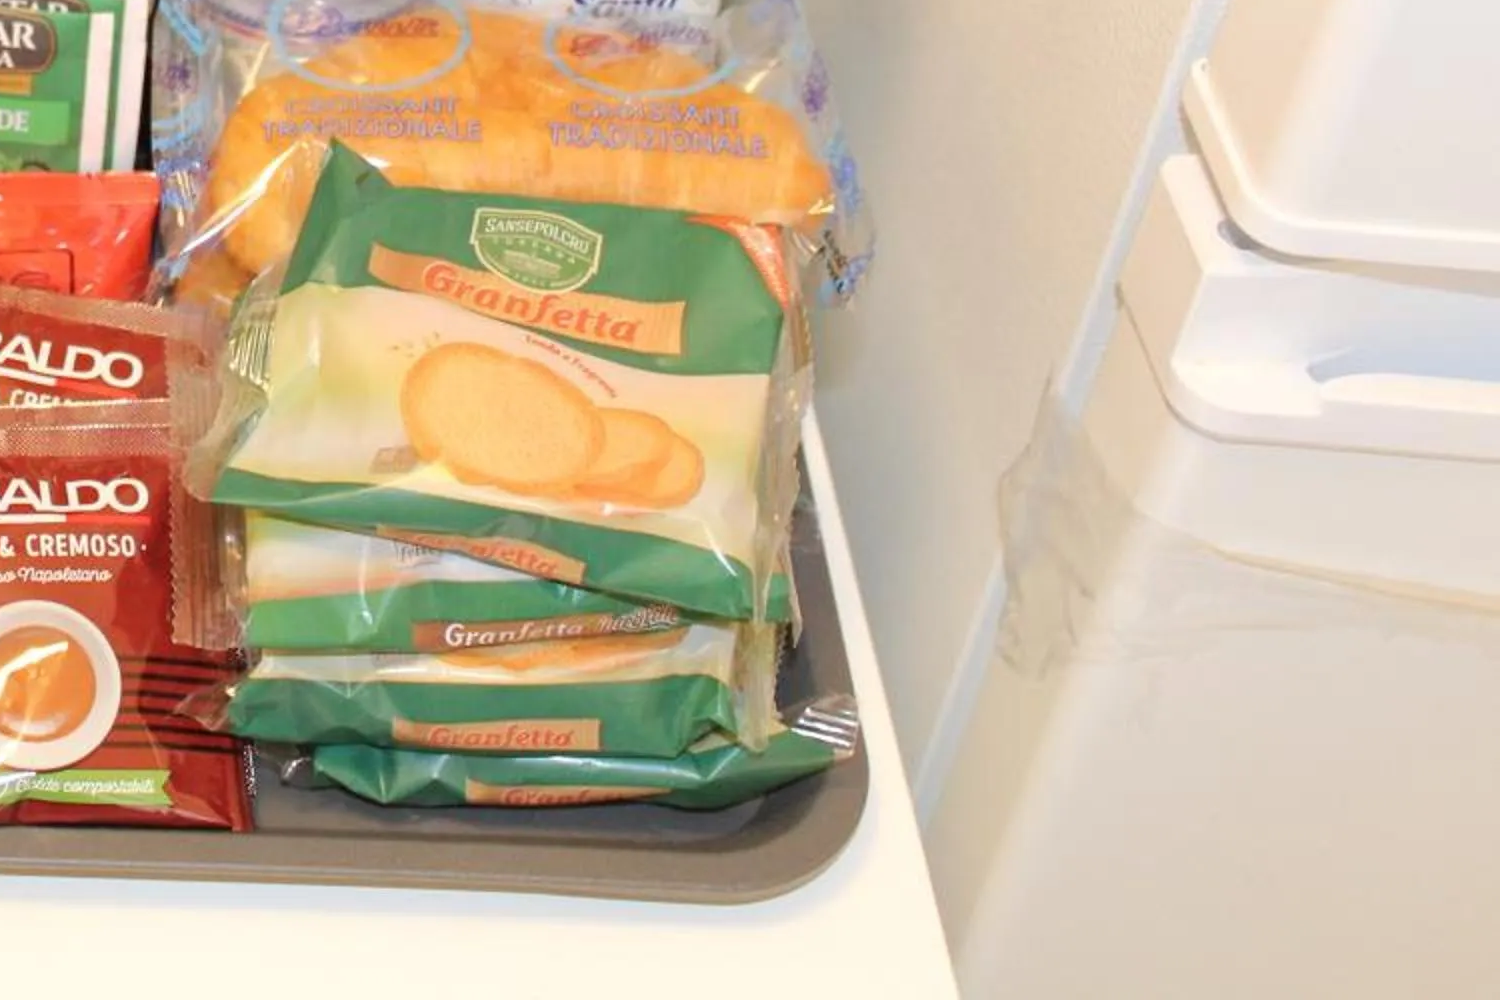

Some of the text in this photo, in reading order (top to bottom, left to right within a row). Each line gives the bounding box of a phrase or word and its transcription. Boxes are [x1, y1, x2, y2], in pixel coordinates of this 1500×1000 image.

[424, 263, 640, 344] Granfetta
[0, 536, 15, 557] &
[25, 533, 136, 558] CREMOSO
[17, 566, 113, 585] Napoletano
[444, 620, 584, 648] Granfetta
[428, 724, 575, 748] Granfetta
[62, 778, 155, 797] compostabili
